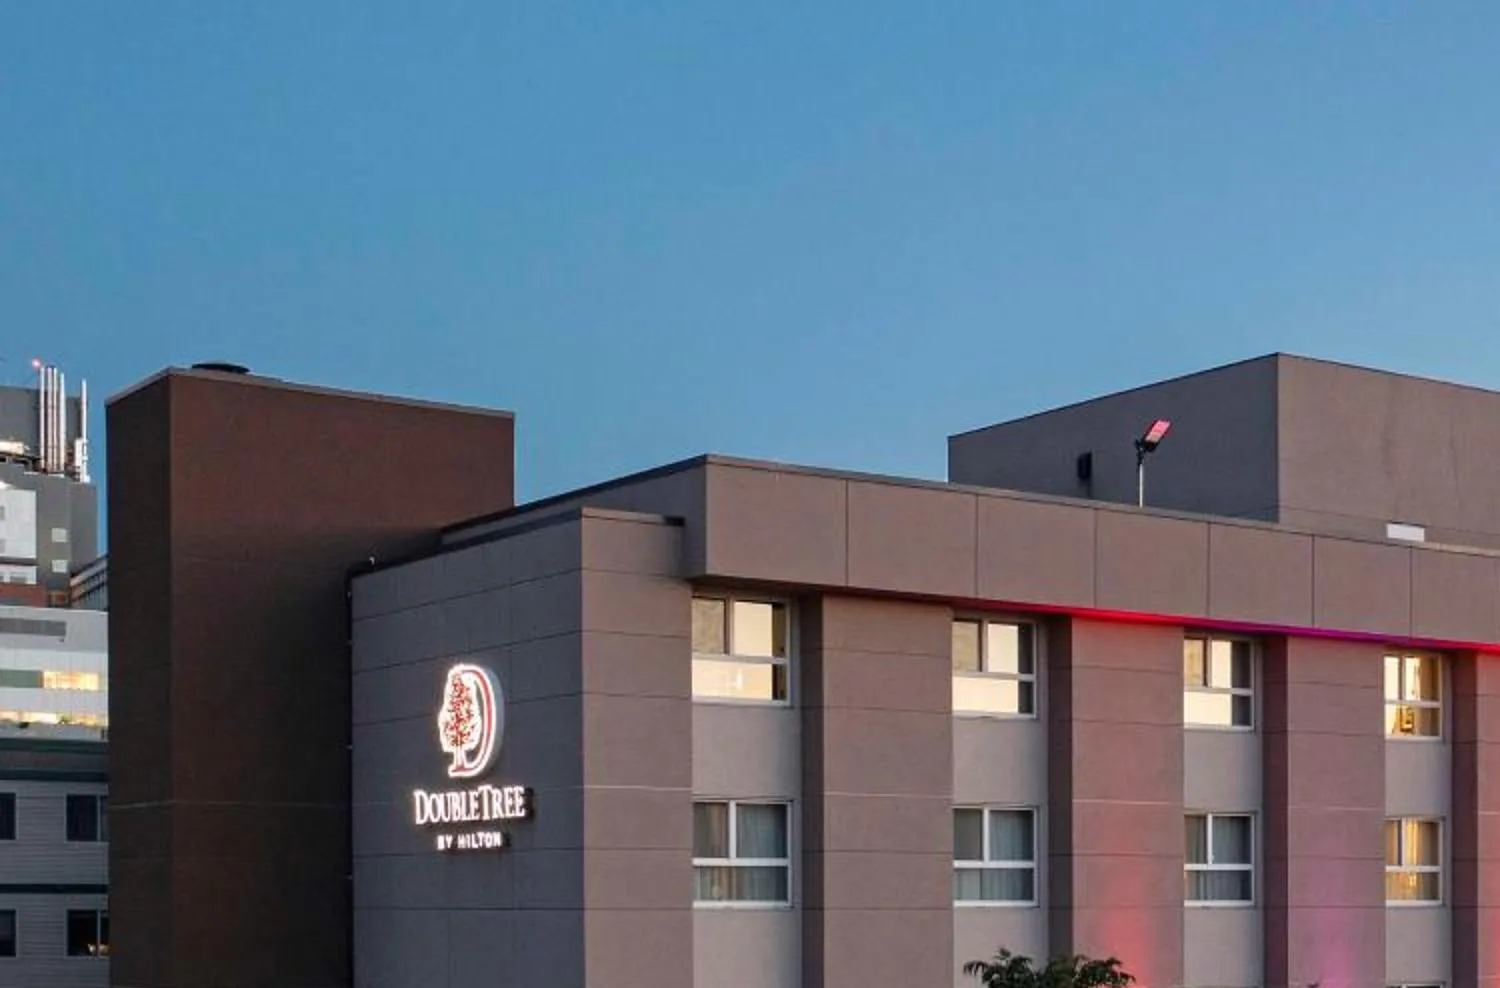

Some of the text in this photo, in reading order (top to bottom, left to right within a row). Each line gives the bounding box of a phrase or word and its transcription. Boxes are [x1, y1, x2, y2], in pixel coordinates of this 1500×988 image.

[413, 784, 527, 825] DOUBLETREE
[437, 831, 503, 850] BY HILTON
